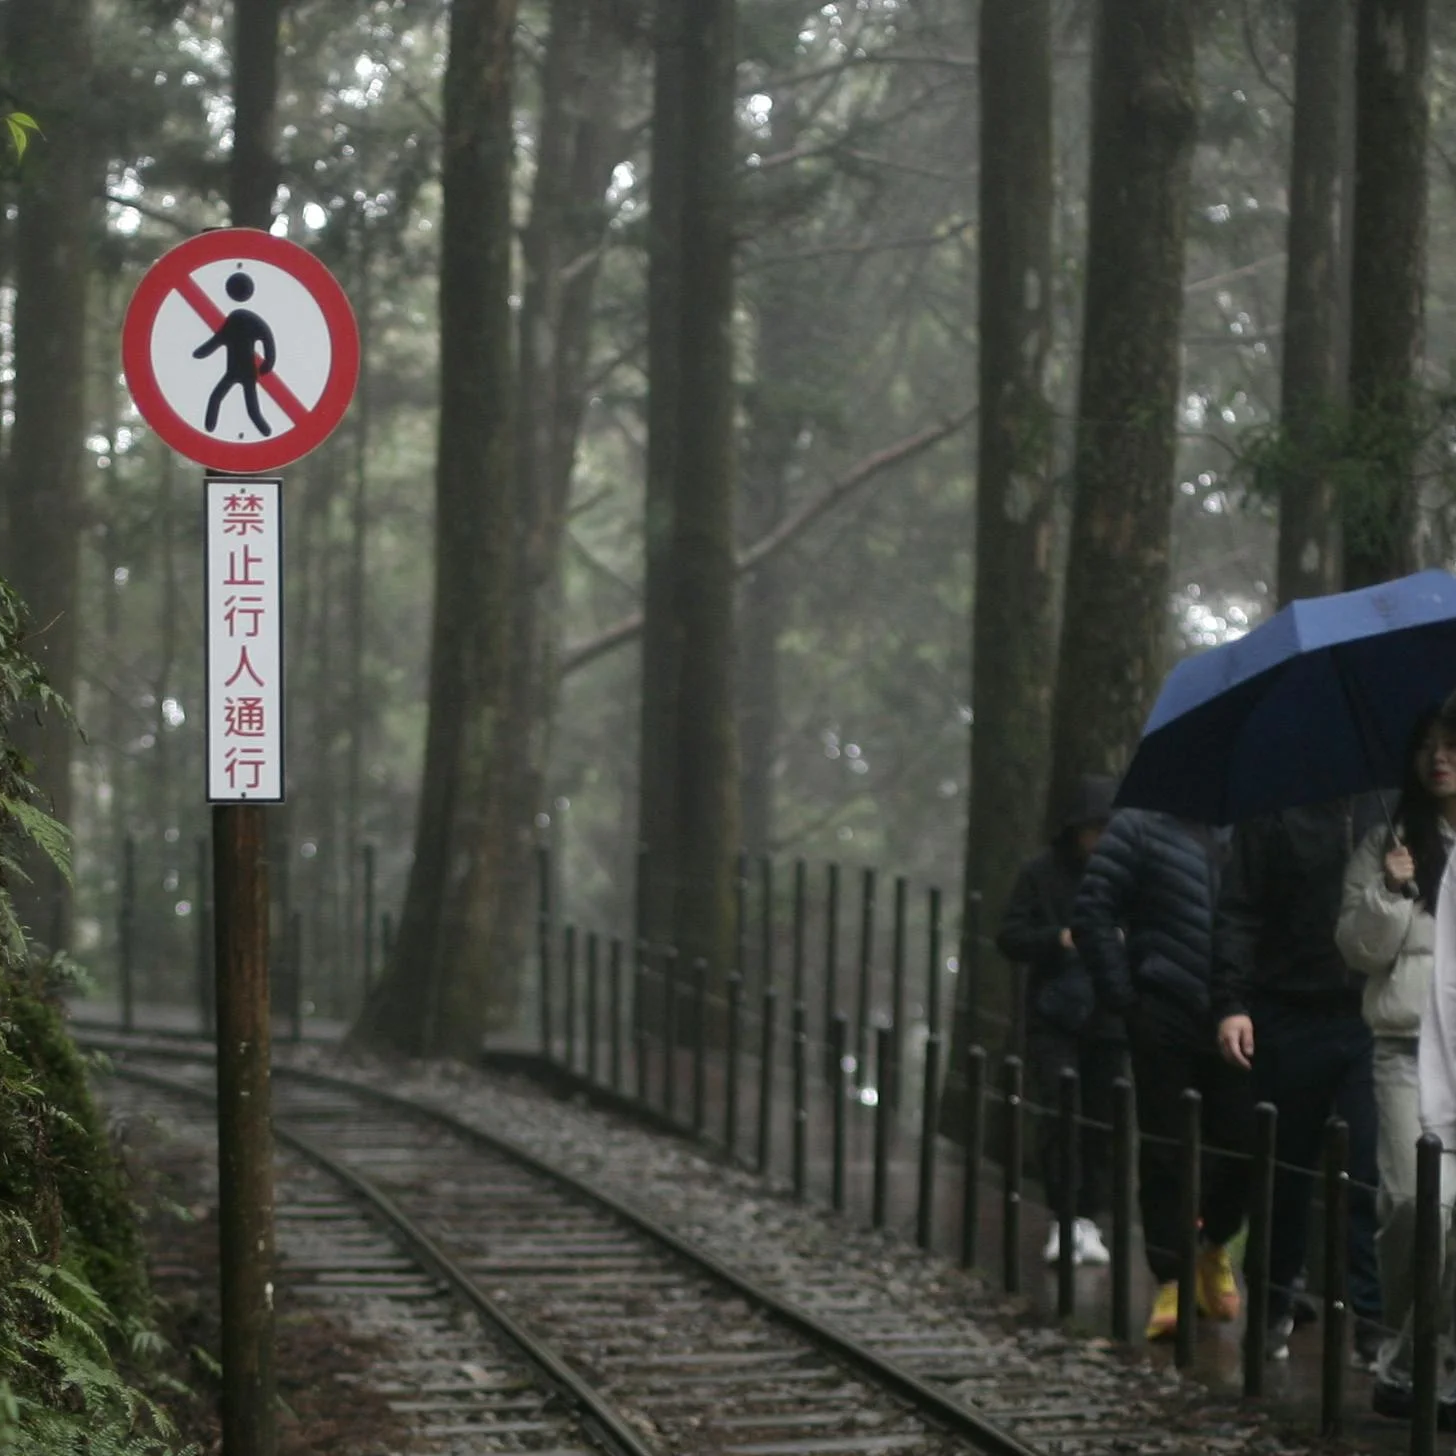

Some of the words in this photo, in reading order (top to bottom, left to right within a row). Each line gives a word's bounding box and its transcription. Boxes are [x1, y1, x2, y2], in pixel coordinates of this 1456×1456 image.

[222, 492, 266, 790] 禁止行人通行
